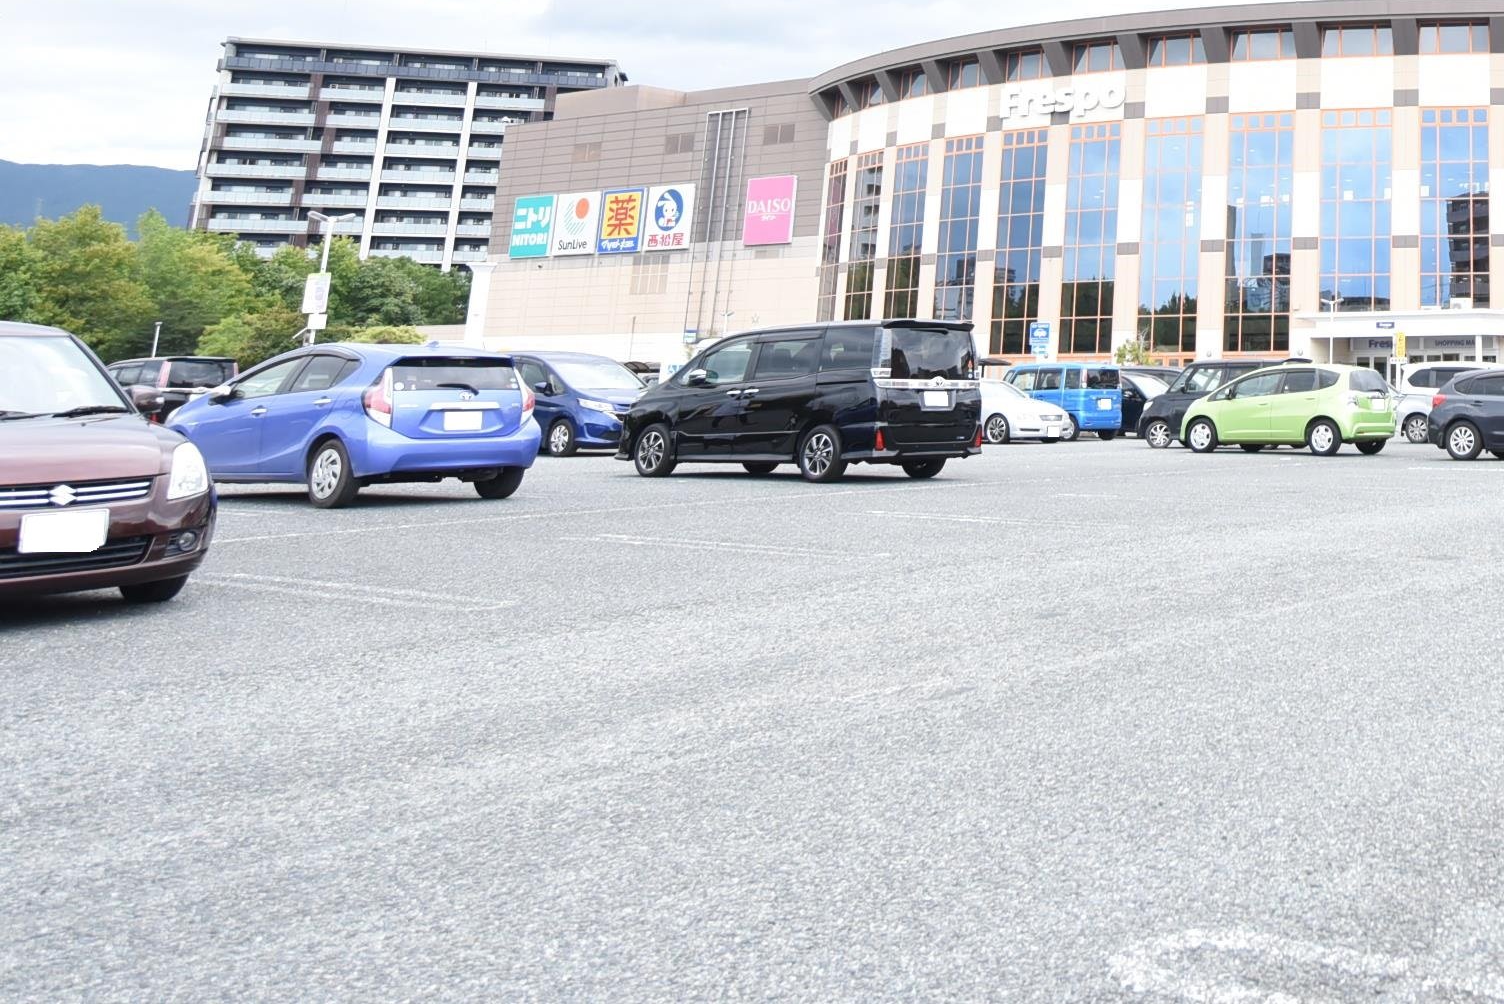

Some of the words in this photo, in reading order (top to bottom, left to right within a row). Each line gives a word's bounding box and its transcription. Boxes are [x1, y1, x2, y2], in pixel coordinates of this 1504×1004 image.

[1000, 84, 1127, 119] Frespo
[747, 198, 791, 214] DAISO
[514, 206, 551, 230] ニトリ
[607, 194, 637, 236] 薬
[512, 233, 548, 247] NITORI
[557, 238, 588, 251] SunLive
[647, 233, 684, 247] 西松屋
